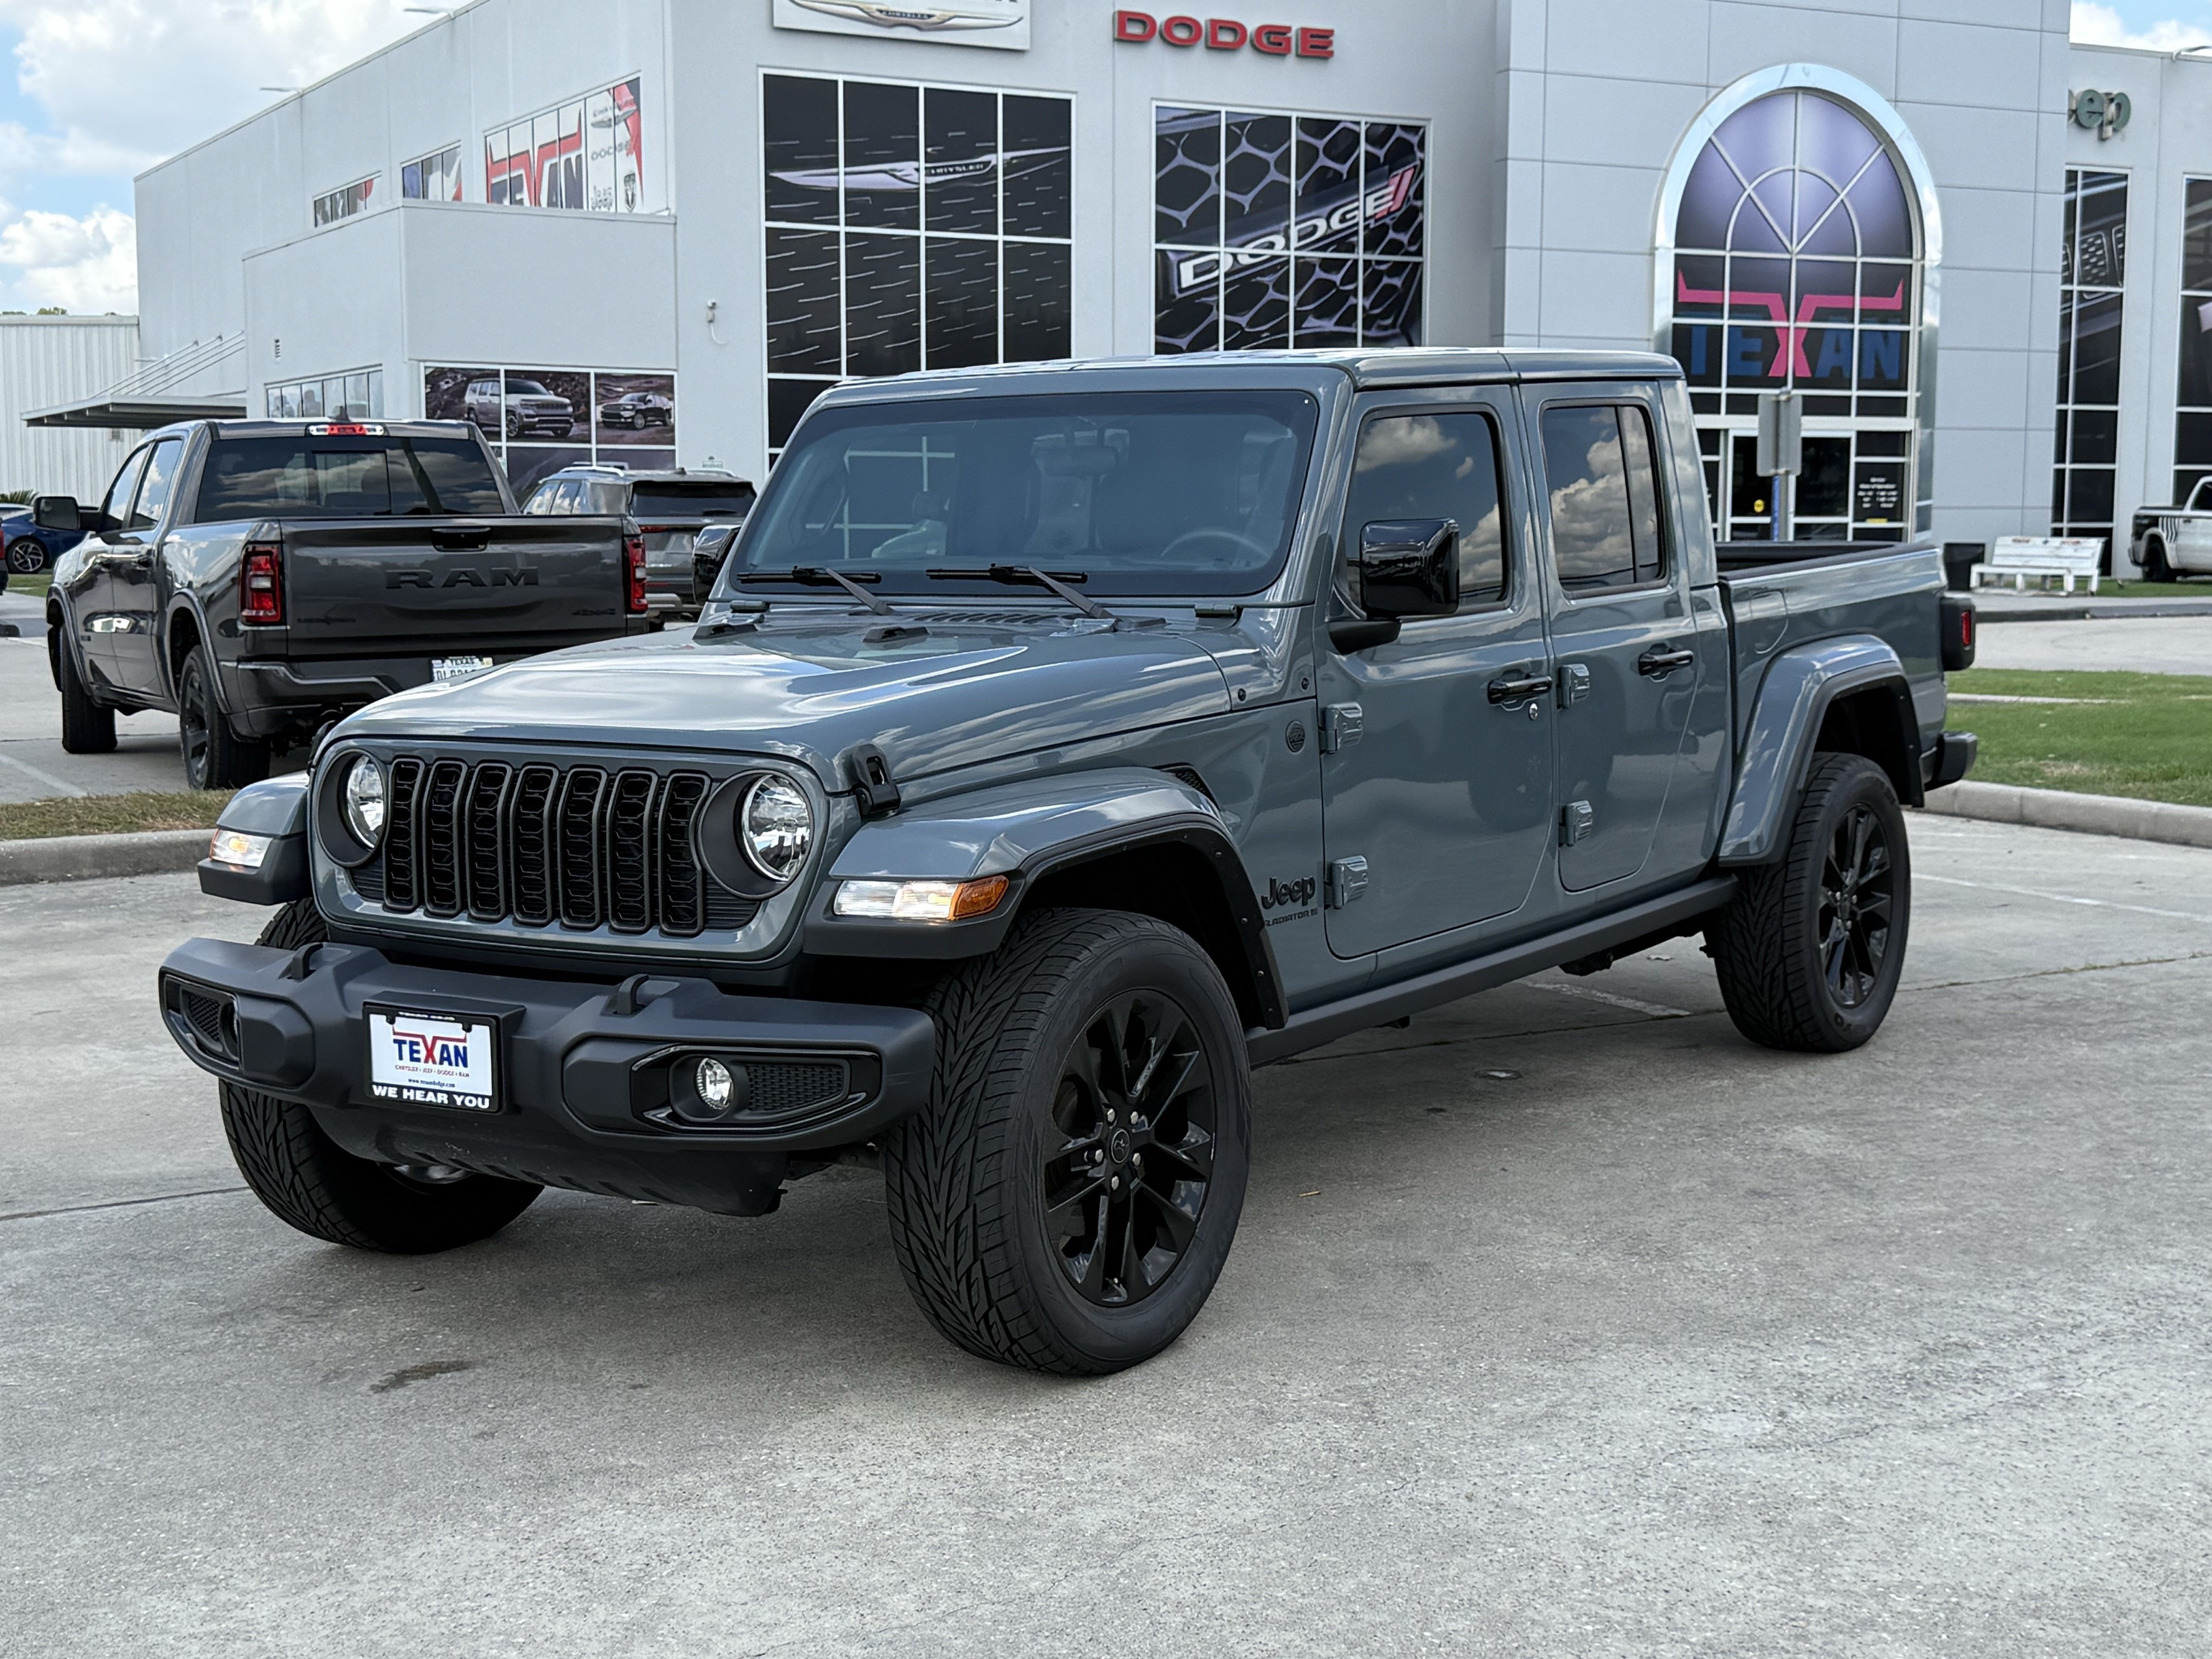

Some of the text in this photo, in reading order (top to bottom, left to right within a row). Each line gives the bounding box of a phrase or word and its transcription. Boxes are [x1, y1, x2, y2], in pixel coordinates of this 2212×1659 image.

[1114, 10, 1334, 59] DODGE
[1179, 184, 1396, 289] DODGE
[1674, 269, 1904, 381] TEXAN
[385, 566, 539, 589] RAM
[1261, 876, 1316, 909] Jeep
[392, 1025, 468, 1068] TEXAN
[372, 1084, 489, 1109] WE HEAR YOU
